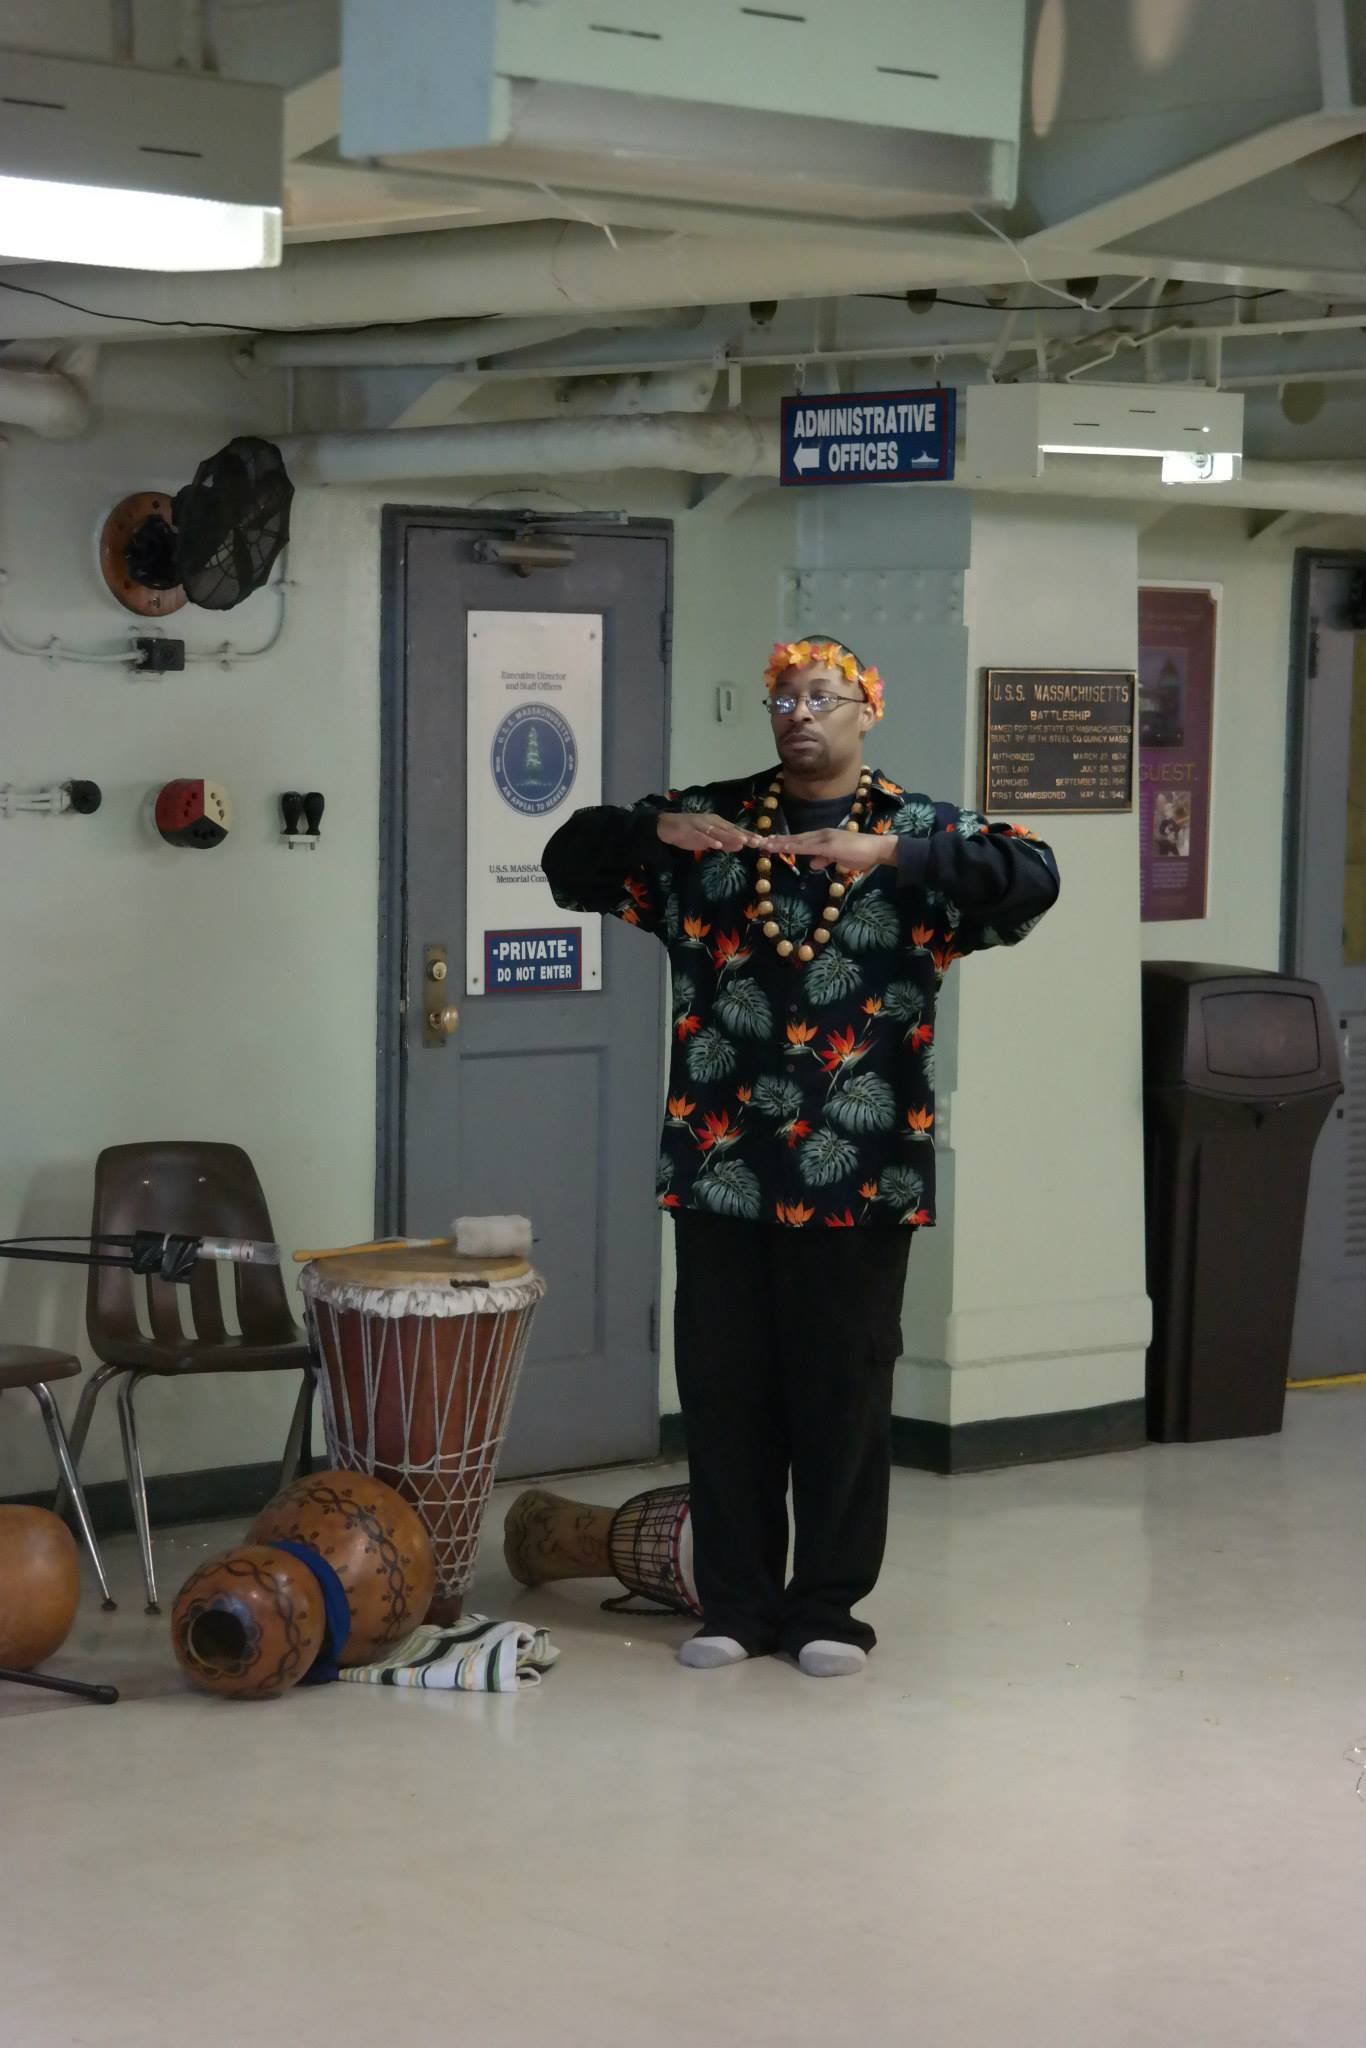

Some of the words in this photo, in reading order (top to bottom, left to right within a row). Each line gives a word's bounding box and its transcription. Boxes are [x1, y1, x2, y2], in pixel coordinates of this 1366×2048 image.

[793, 403, 936, 438] ADMINISTRATIVE
[828, 441, 899, 472] OFFICES
[537, 672, 567, 681] Director
[505, 682, 519, 690] and
[993, 684, 1025, 701] U.S.S.
[1034, 684, 1129, 703] MASSACHUSETTS
[1030, 710, 1091, 721] BATTLESHIP
[991, 752, 1036, 761] AUTHORIZED
[991, 778, 1029, 787] LAUNCHED
[1055, 778, 1097, 787] SEPTEMBER
[1014, 791, 1067, 800] COMMISSIONED
[496, 875, 530, 883] Memorial
[497, 968, 512, 982] DO
[516, 966, 536, 981] NOT
[540, 965, 572, 980] ENTER
